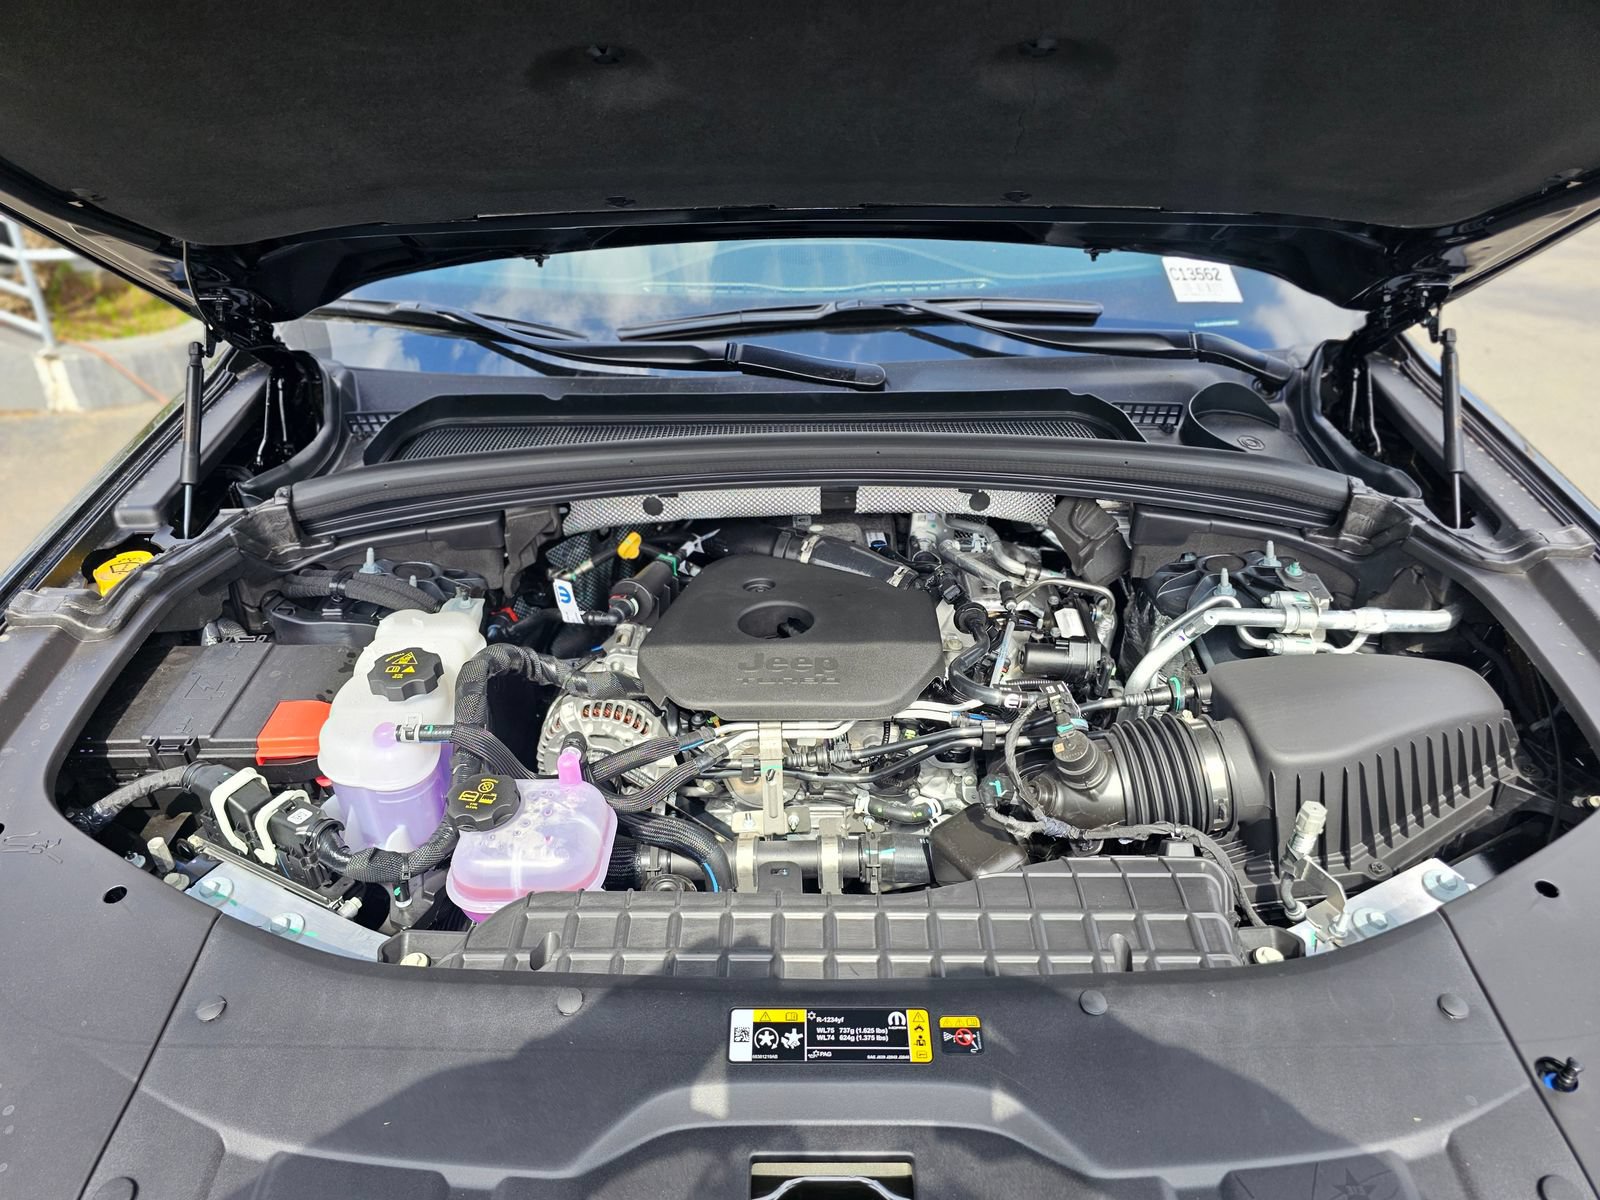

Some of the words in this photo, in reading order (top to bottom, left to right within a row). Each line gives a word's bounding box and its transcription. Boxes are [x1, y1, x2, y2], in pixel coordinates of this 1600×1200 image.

[1169, 266, 1222, 281] C13562
[737, 652, 839, 676] Jeep
[816, 1016, 844, 1024] R-1234yf
[839, 1027, 855, 1035] 737g
[876, 1027, 888, 1035] lbs)
[839, 1034, 855, 1042] 624g
[856, 1034, 875, 1042] (1.375
[876, 1034, 889, 1042] lbs)
